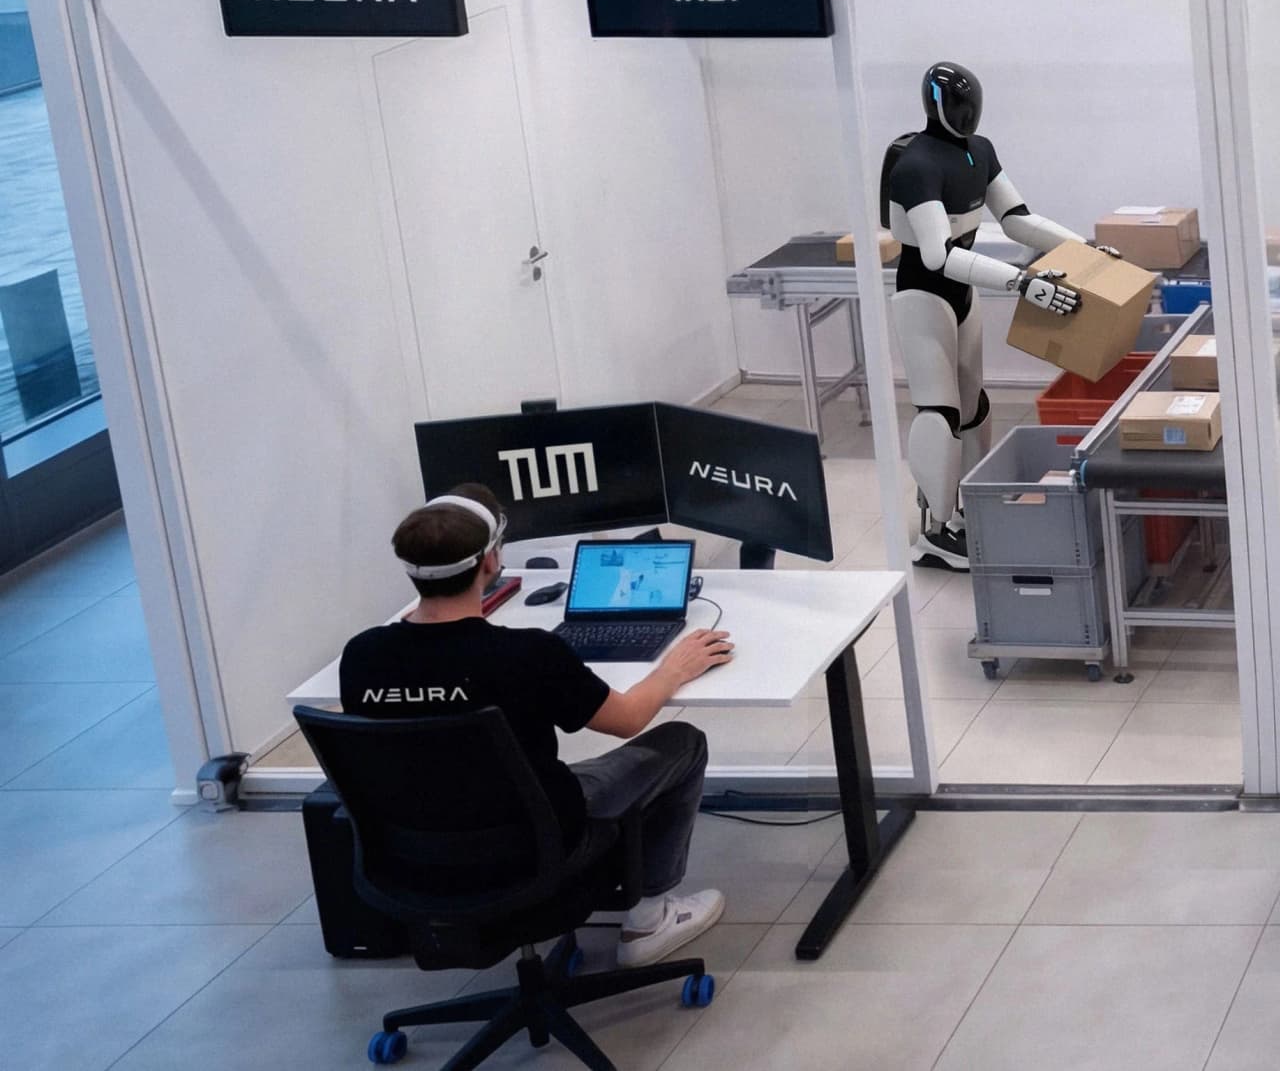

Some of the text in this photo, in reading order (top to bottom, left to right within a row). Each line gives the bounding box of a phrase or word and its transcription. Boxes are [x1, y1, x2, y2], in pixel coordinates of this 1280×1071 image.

[498, 442, 599, 501] TUM
[689, 461, 797, 501] NEURA
[362, 686, 469, 703] NEURA
